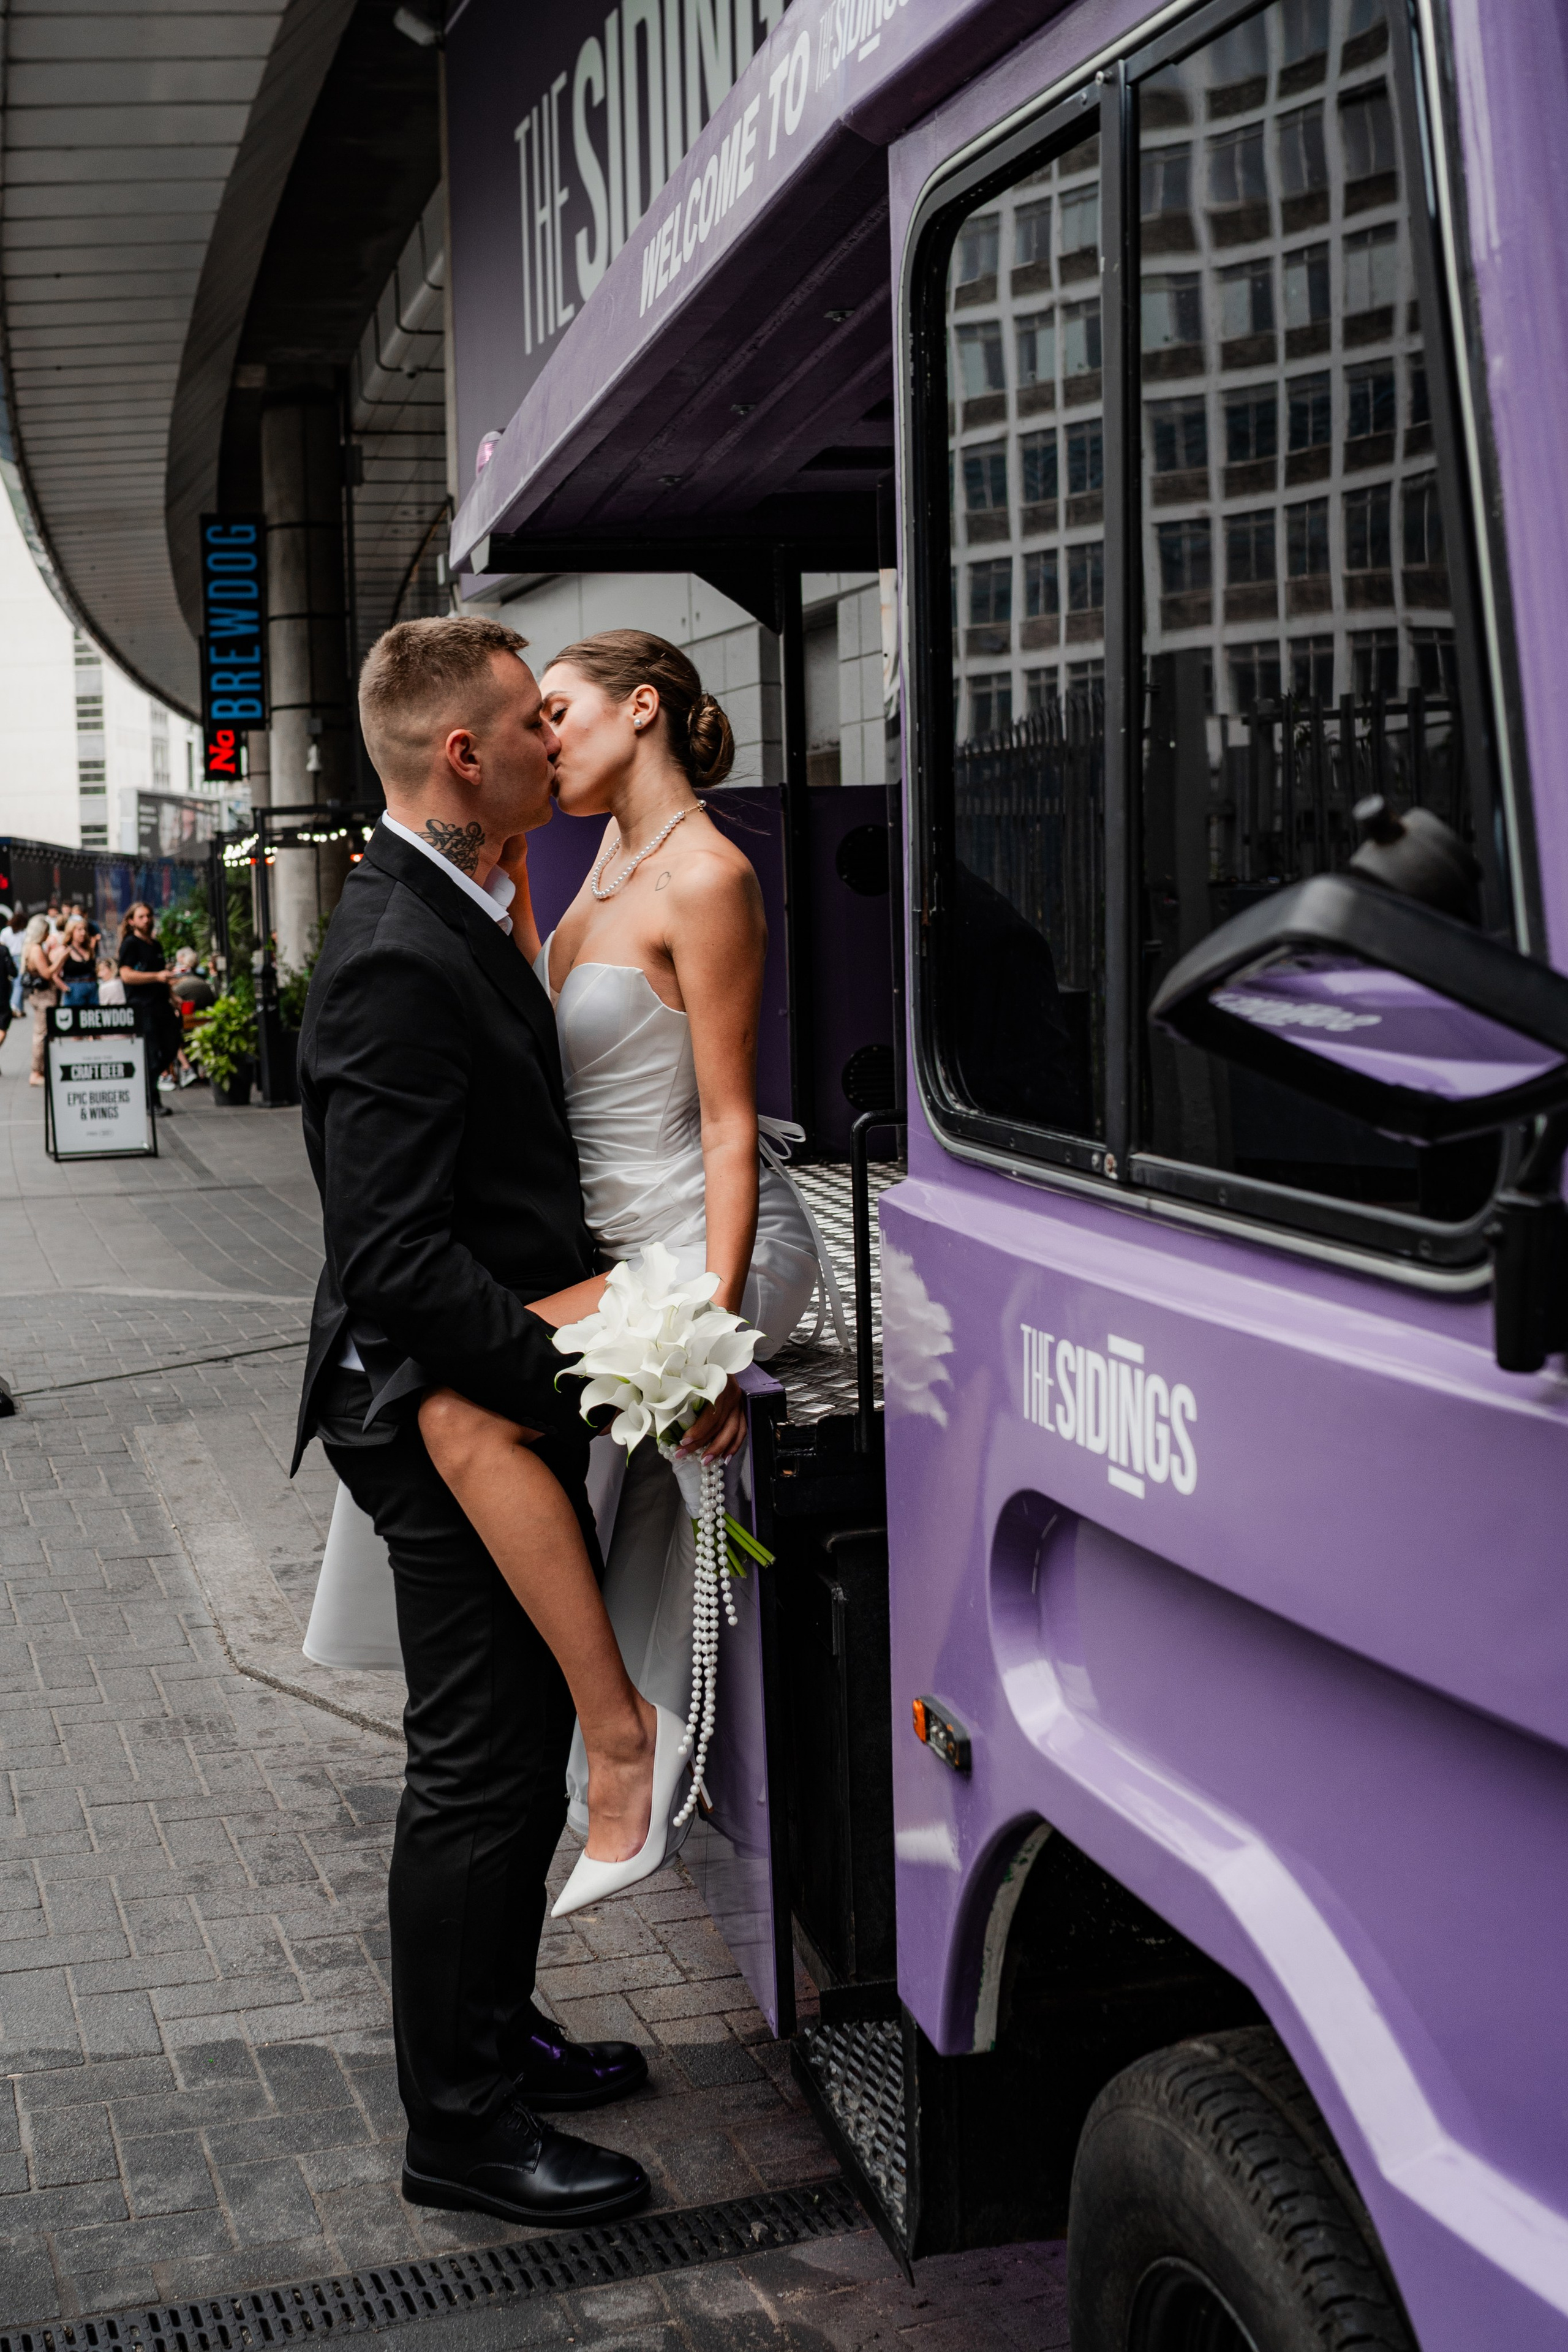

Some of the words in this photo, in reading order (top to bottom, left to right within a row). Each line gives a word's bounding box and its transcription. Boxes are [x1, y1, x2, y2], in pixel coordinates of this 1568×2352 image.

[515, 70, 575, 356] THE
[571, 0, 786, 303] SIDI
[639, 92, 761, 318] WELCOME
[768, 30, 810, 160] TO
[815, 0, 838, 92] THE
[831, 0, 910, 70] SIDI
[206, 524, 263, 720] BREWDOG
[79, 1008, 134, 1029] BREWDOG
[67, 1091, 87, 1106] EPIC
[89, 1090, 130, 1105] BURGERS
[70, 1063, 98, 1081] CRAFT
[100, 1062, 124, 1080] BEER
[80, 1107, 88, 1121] &
[89, 1106, 119, 1121] WINGS
[1020, 1322, 1055, 1433] THE
[1055, 1334, 1197, 1499] SIDINGS
